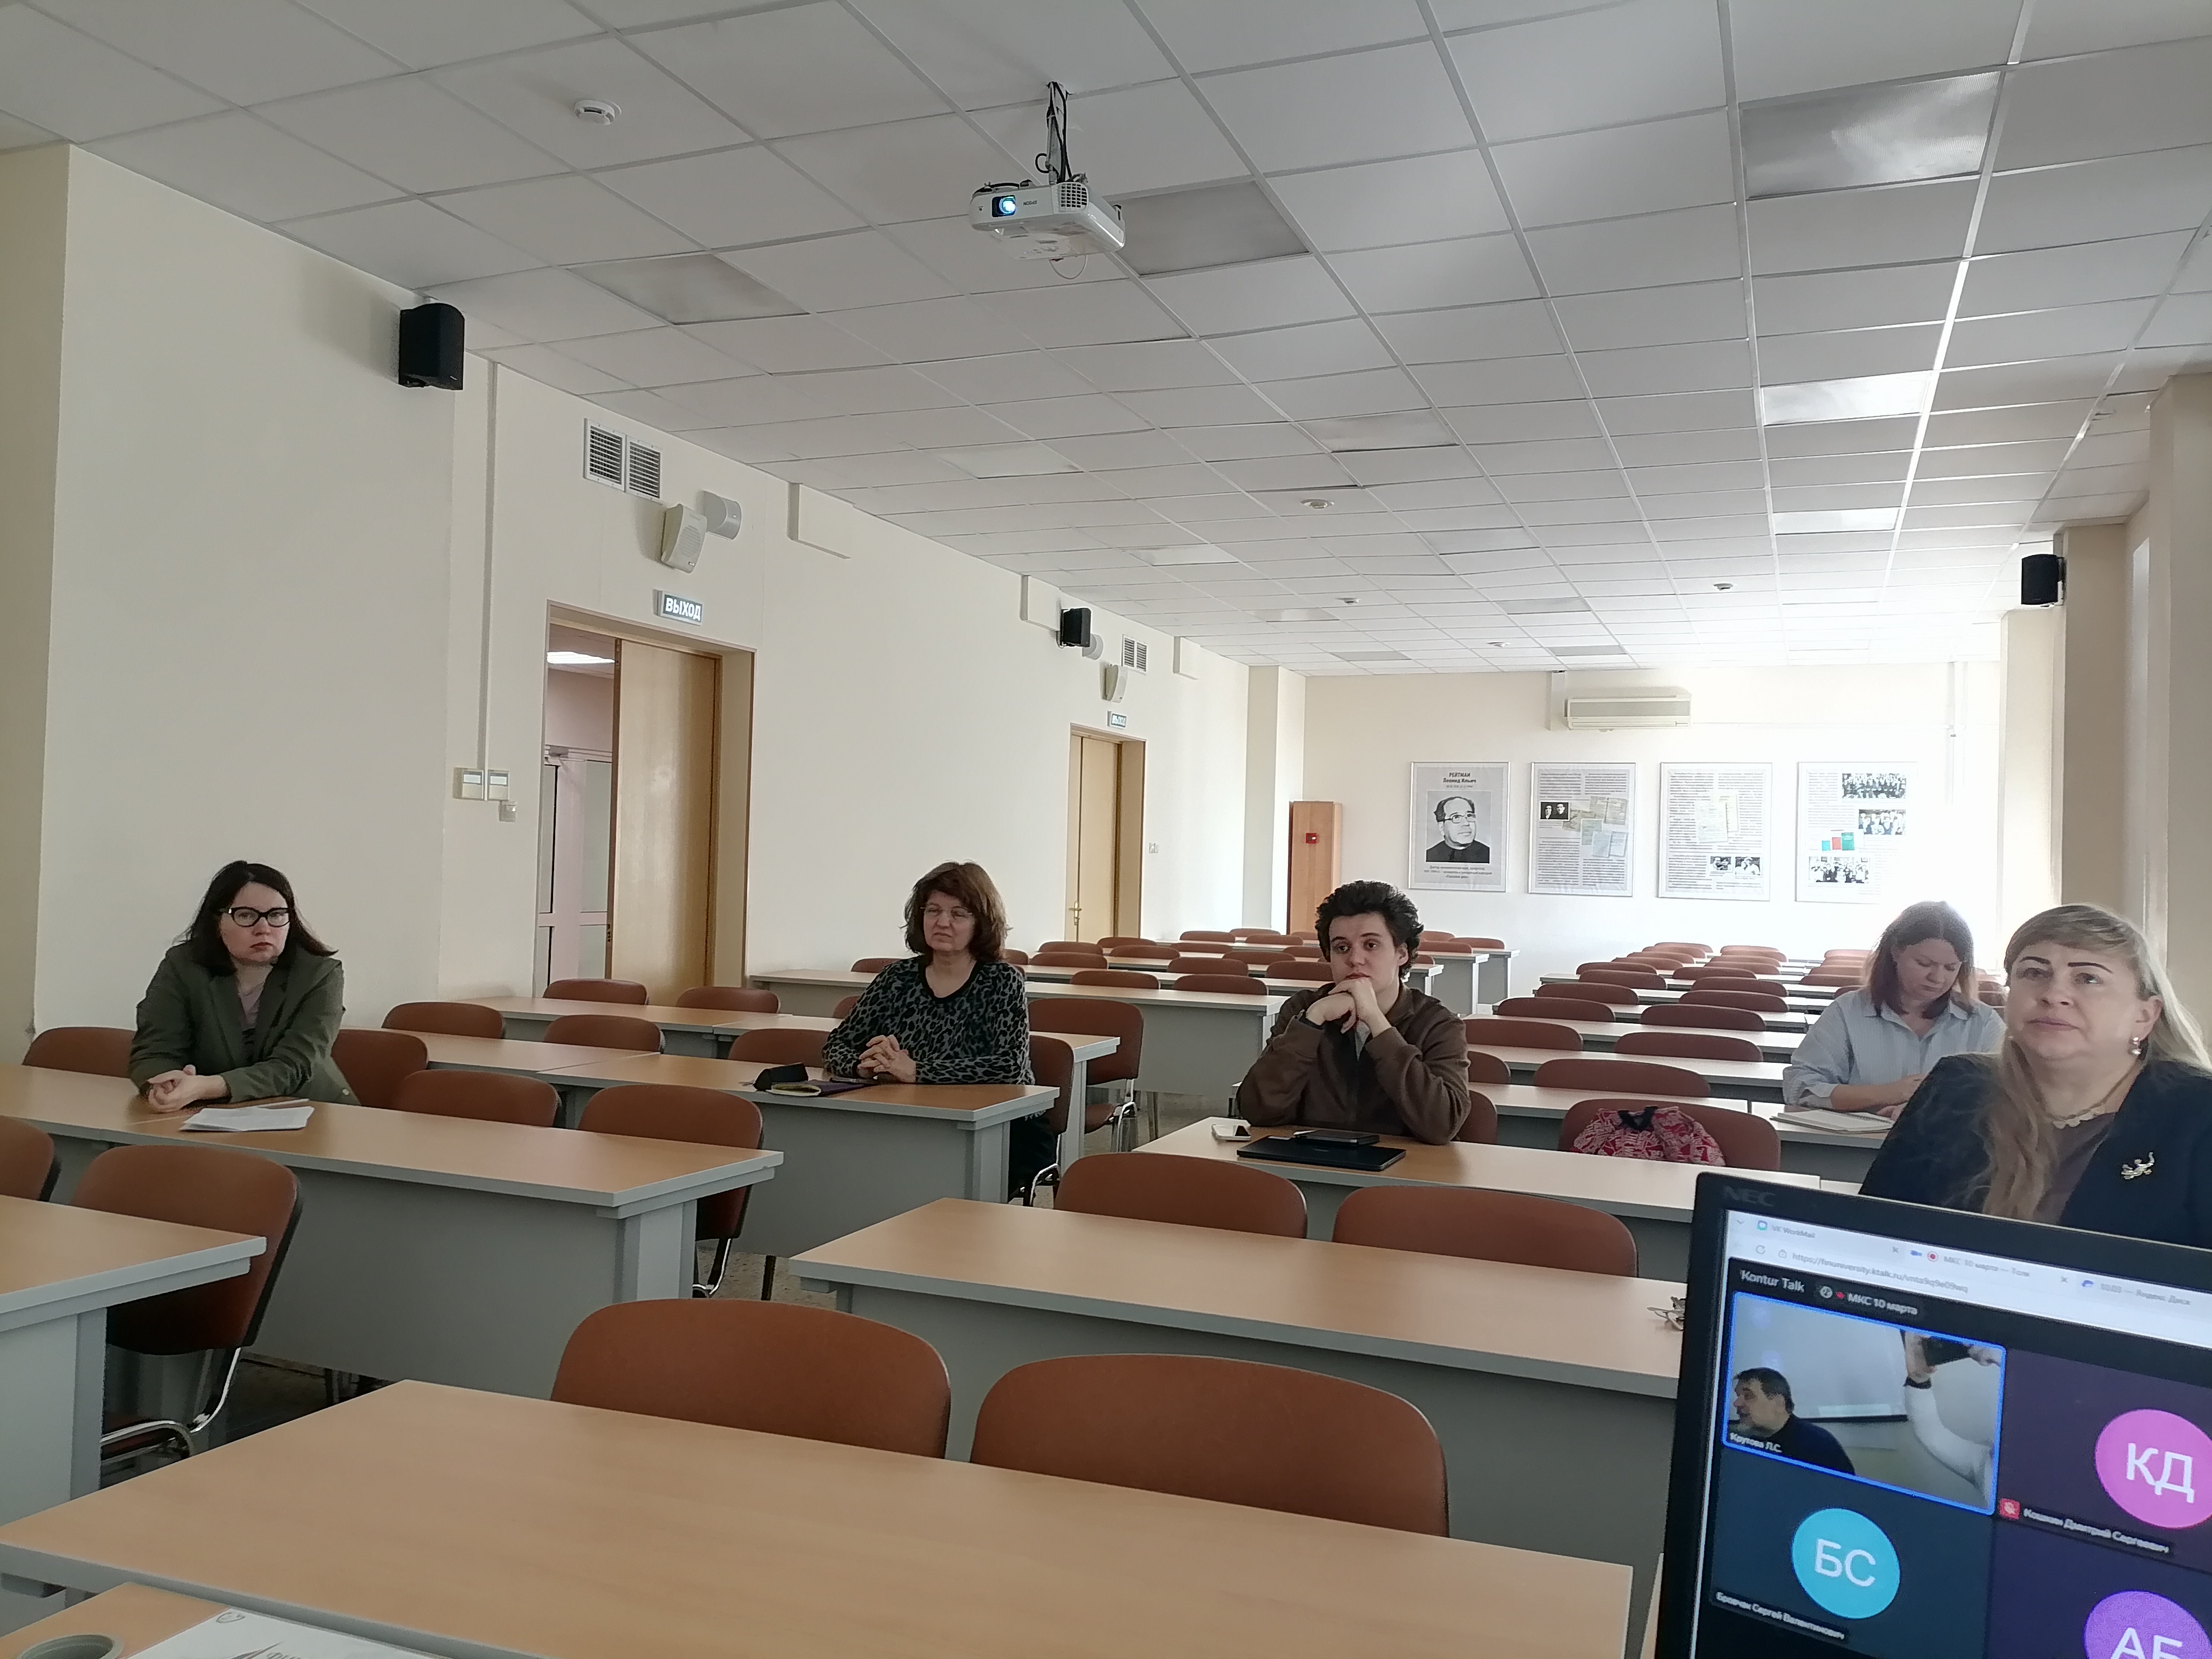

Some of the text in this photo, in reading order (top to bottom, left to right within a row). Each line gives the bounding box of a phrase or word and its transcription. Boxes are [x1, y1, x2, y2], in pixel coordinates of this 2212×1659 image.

[665, 597, 701, 621] ВЫХОД
[1724, 1185, 1776, 1208] NEC
[1739, 1270, 1805, 1293] Kontur Talk
[1848, 1293, 1918, 1315] МКС 10 марта
[2126, 1442, 2195, 1504] КД
[1815, 1538, 1876, 1587] БС
